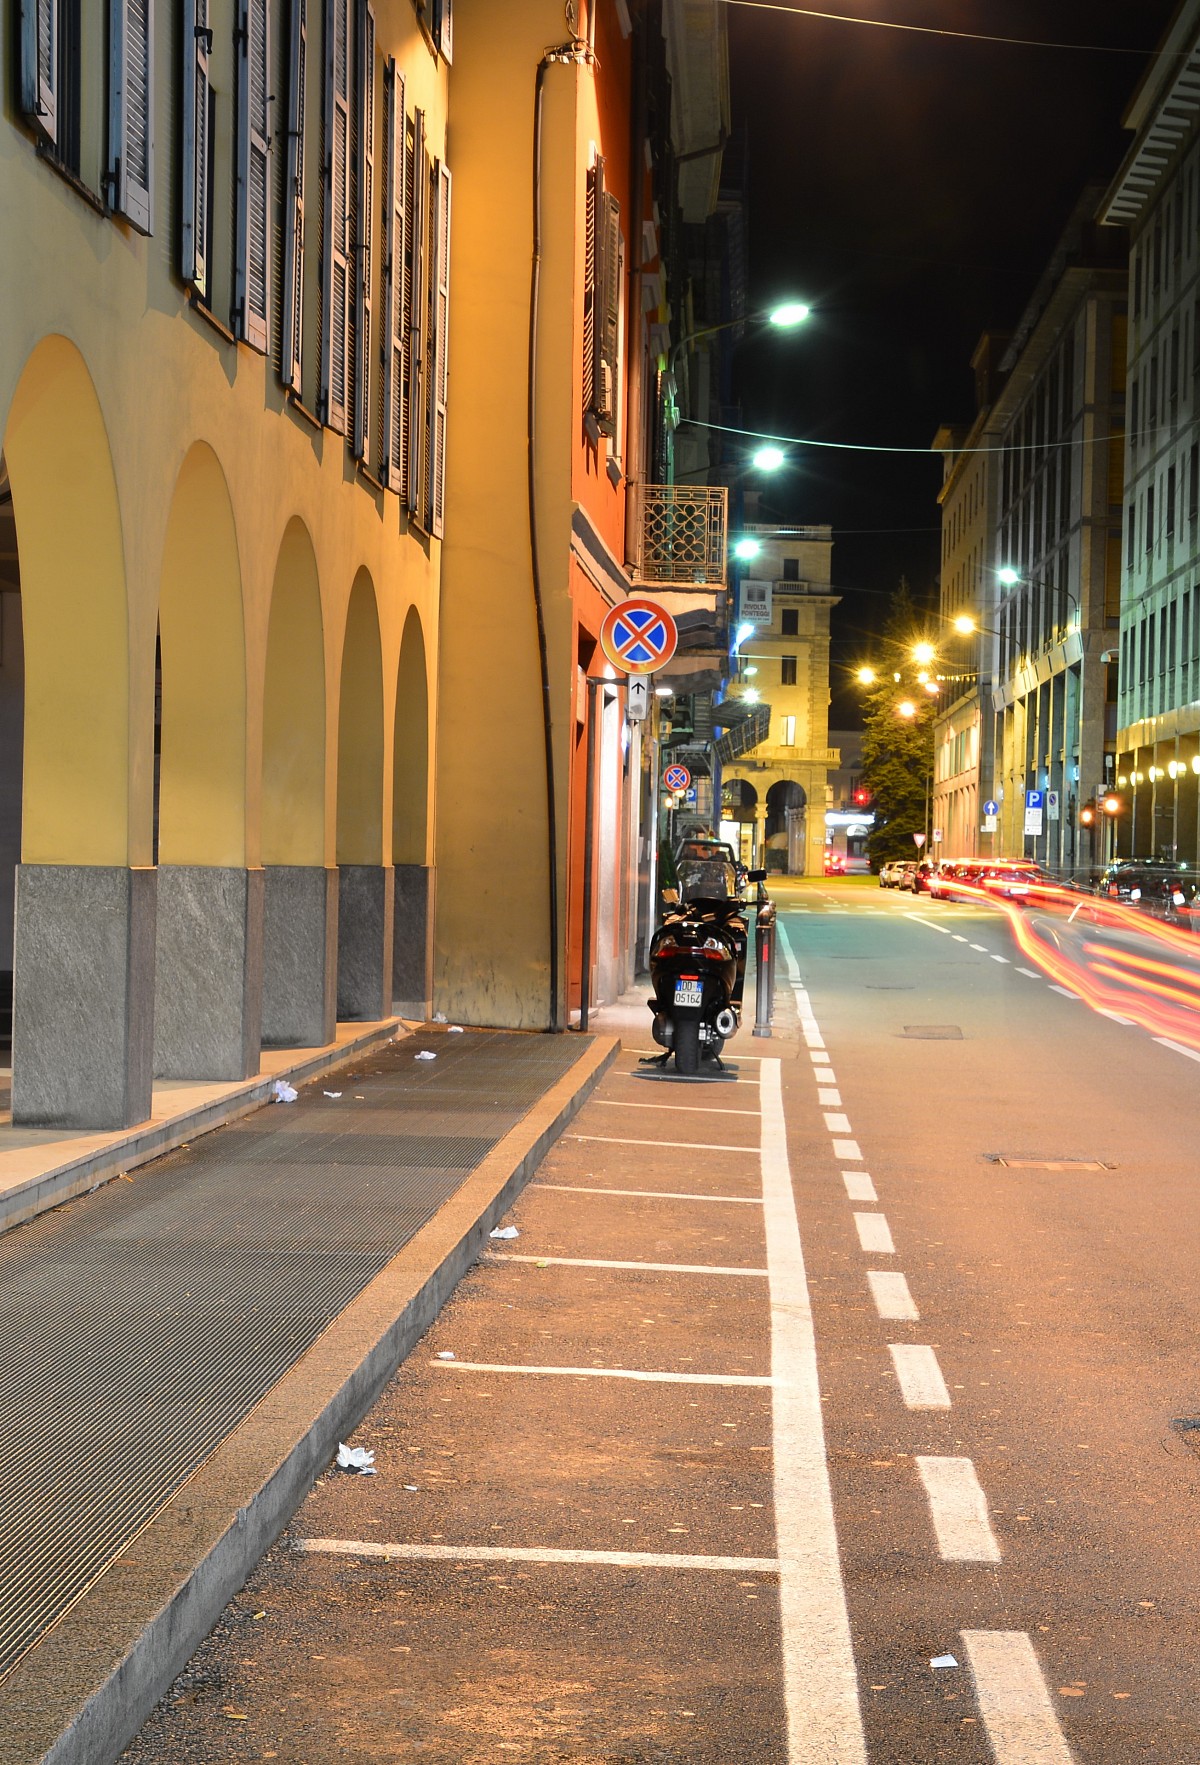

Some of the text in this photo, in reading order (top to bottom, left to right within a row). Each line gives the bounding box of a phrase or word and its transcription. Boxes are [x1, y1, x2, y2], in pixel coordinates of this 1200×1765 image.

[1028, 792, 1040, 807] P
[682, 981, 693, 991] DD
[675, 993, 700, 1004] 05164
